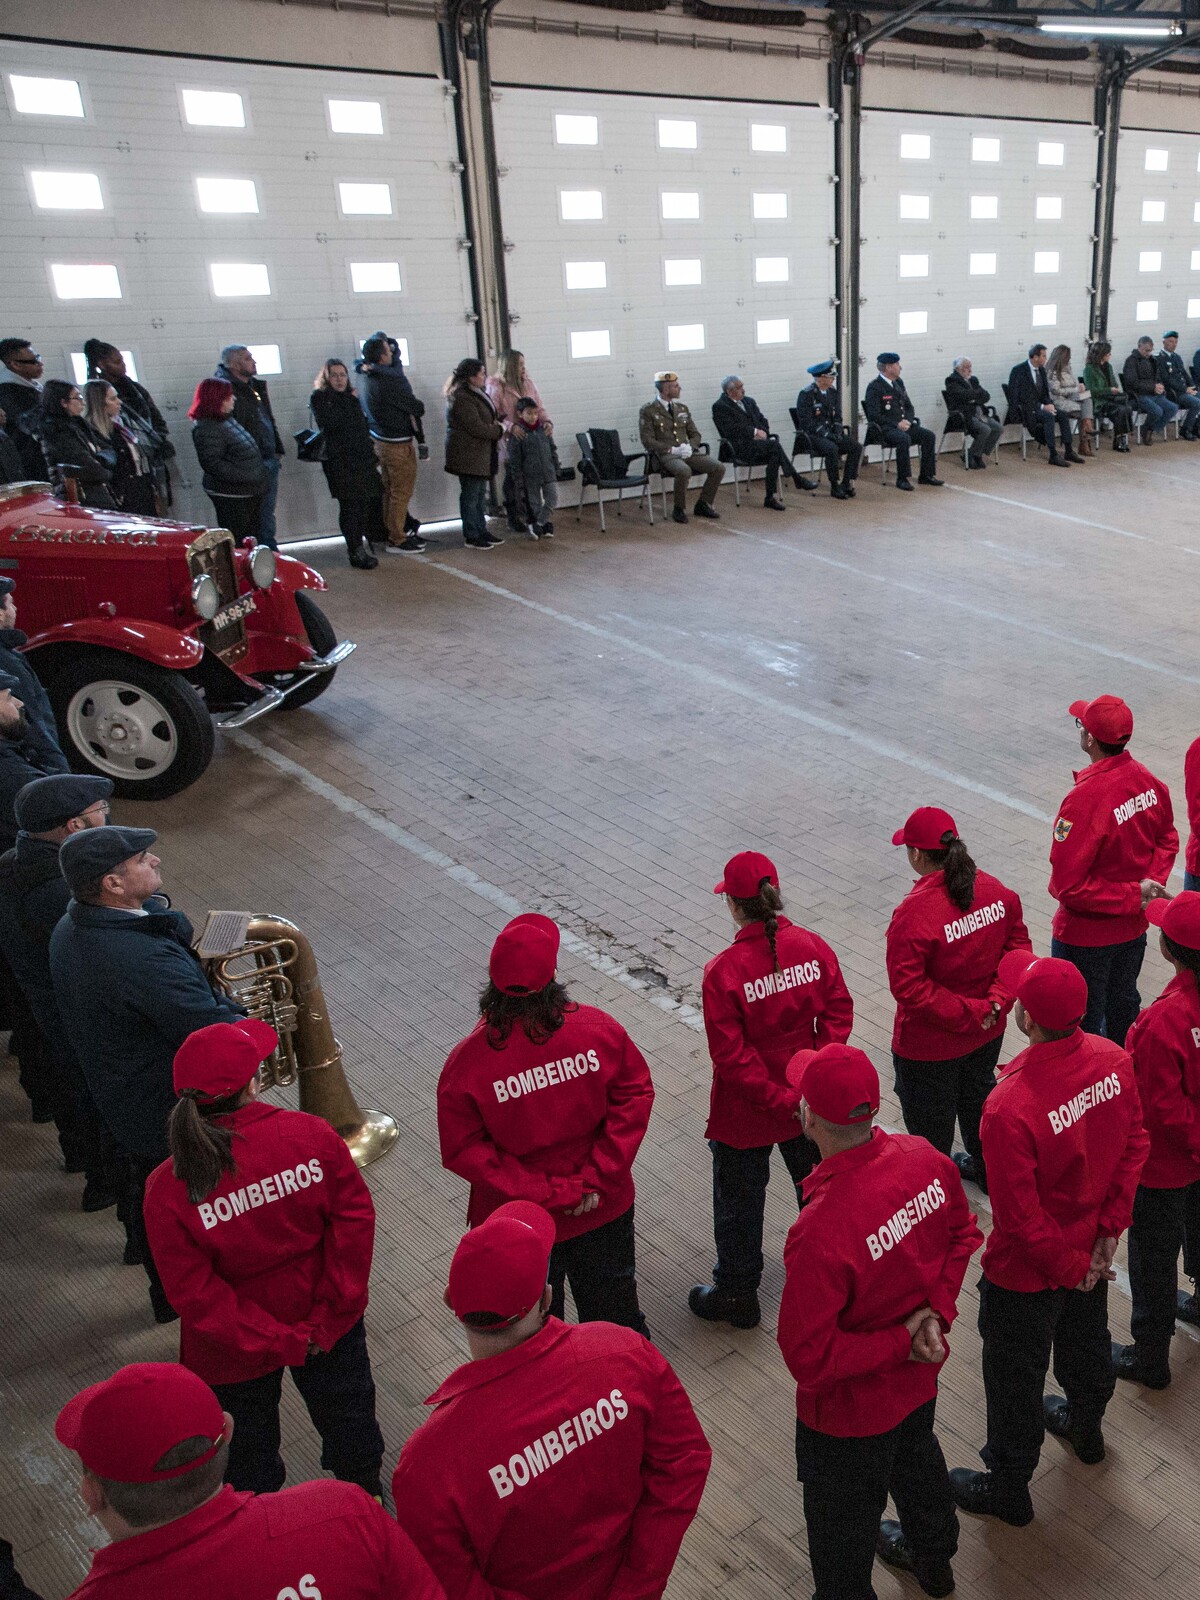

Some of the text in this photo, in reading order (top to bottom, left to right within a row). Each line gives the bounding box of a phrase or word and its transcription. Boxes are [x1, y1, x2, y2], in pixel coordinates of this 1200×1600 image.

[1113, 788, 1158, 825] BOMBEROS
[943, 900, 1006, 943] BOMBEIROS
[743, 959, 821, 1003] BOMBEIROS
[492, 1048, 601, 1104] BOMBEIROS
[1047, 1072, 1121, 1135] BOMBEIROS
[197, 1158, 324, 1231] BOMBEIROS
[865, 1178, 946, 1262] BOMBEIROS
[487, 1388, 629, 1499] BOMBEIROS
